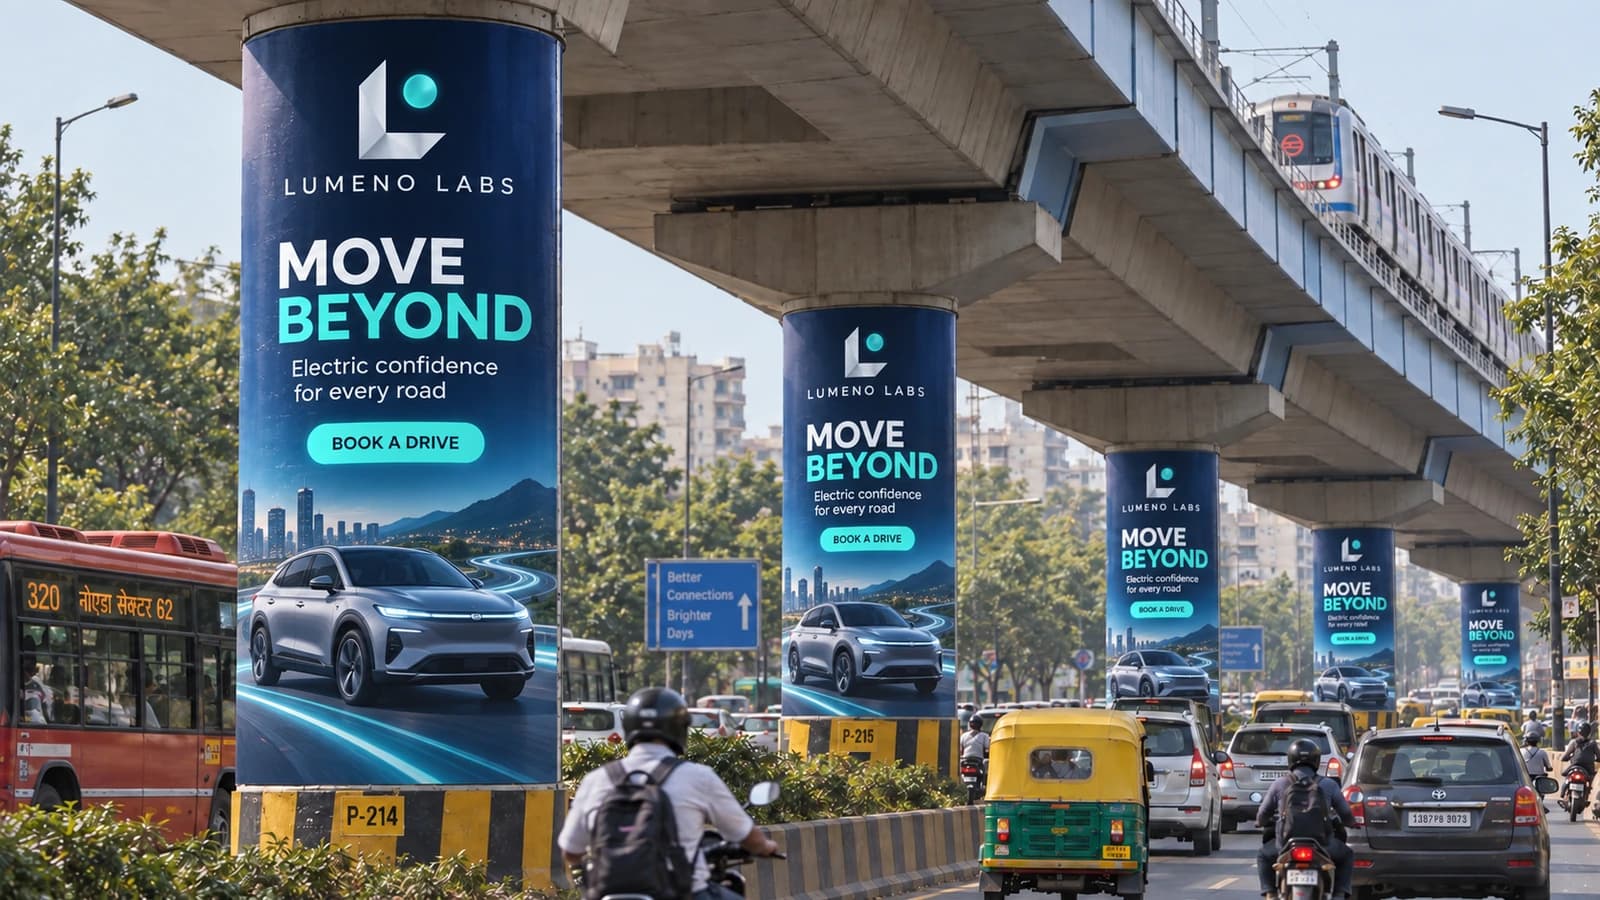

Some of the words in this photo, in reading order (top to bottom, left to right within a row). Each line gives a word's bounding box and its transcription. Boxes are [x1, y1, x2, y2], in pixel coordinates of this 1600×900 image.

[285, 175, 415, 195] LUMENO
[437, 176, 513, 194] LABS
[278, 237, 464, 289] MOVE
[278, 292, 532, 344] BEYOND
[292, 357, 368, 377] Electric
[376, 356, 498, 375] confidence
[294, 384, 323, 402] for
[329, 384, 389, 403] every
[397, 381, 446, 399] road
[808, 385, 874, 399] LUMENO
[885, 385, 925, 397] LABS
[332, 436, 384, 450] BOOK
[389, 436, 400, 449] A
[406, 435, 459, 450] DRIVE
[807, 420, 904, 451] MOVE
[807, 451, 938, 482] BEYOND
[814, 489, 855, 502] Electric
[858, 488, 922, 500] confidence
[815, 504, 830, 516] for
[833, 505, 865, 517] every
[869, 503, 895, 514] road
[1122, 504, 1167, 513] LUMENO
[1173, 504, 1200, 512] LABS
[833, 535, 860, 544] BOOK
[863, 535, 871, 543] A
[874, 534, 902, 544] DRIVE
[1121, 527, 1186, 548] MOVE
[1121, 549, 1208, 570] BEYOND
[667, 571, 702, 583] Better
[1126, 574, 1154, 583] Electric
[1155, 573, 1200, 583] confidence
[27, 581, 60, 611] 320
[667, 589, 734, 601] Connections
[1139, 585, 1161, 594] every
[1163, 584, 1181, 593] road
[1323, 582, 1371, 597] MOVE
[79, 585, 112, 616] नोएडा
[116, 589, 152, 618] सेक्टर
[156, 598, 174, 621] 62
[1323, 596, 1387, 612] BEYOND
[667, 609, 712, 624] Brighter
[1469, 620, 1503, 630] MOVE
[667, 627, 694, 641] Days
[843, 729, 874, 743] P-215
[347, 805, 399, 826] P-214
